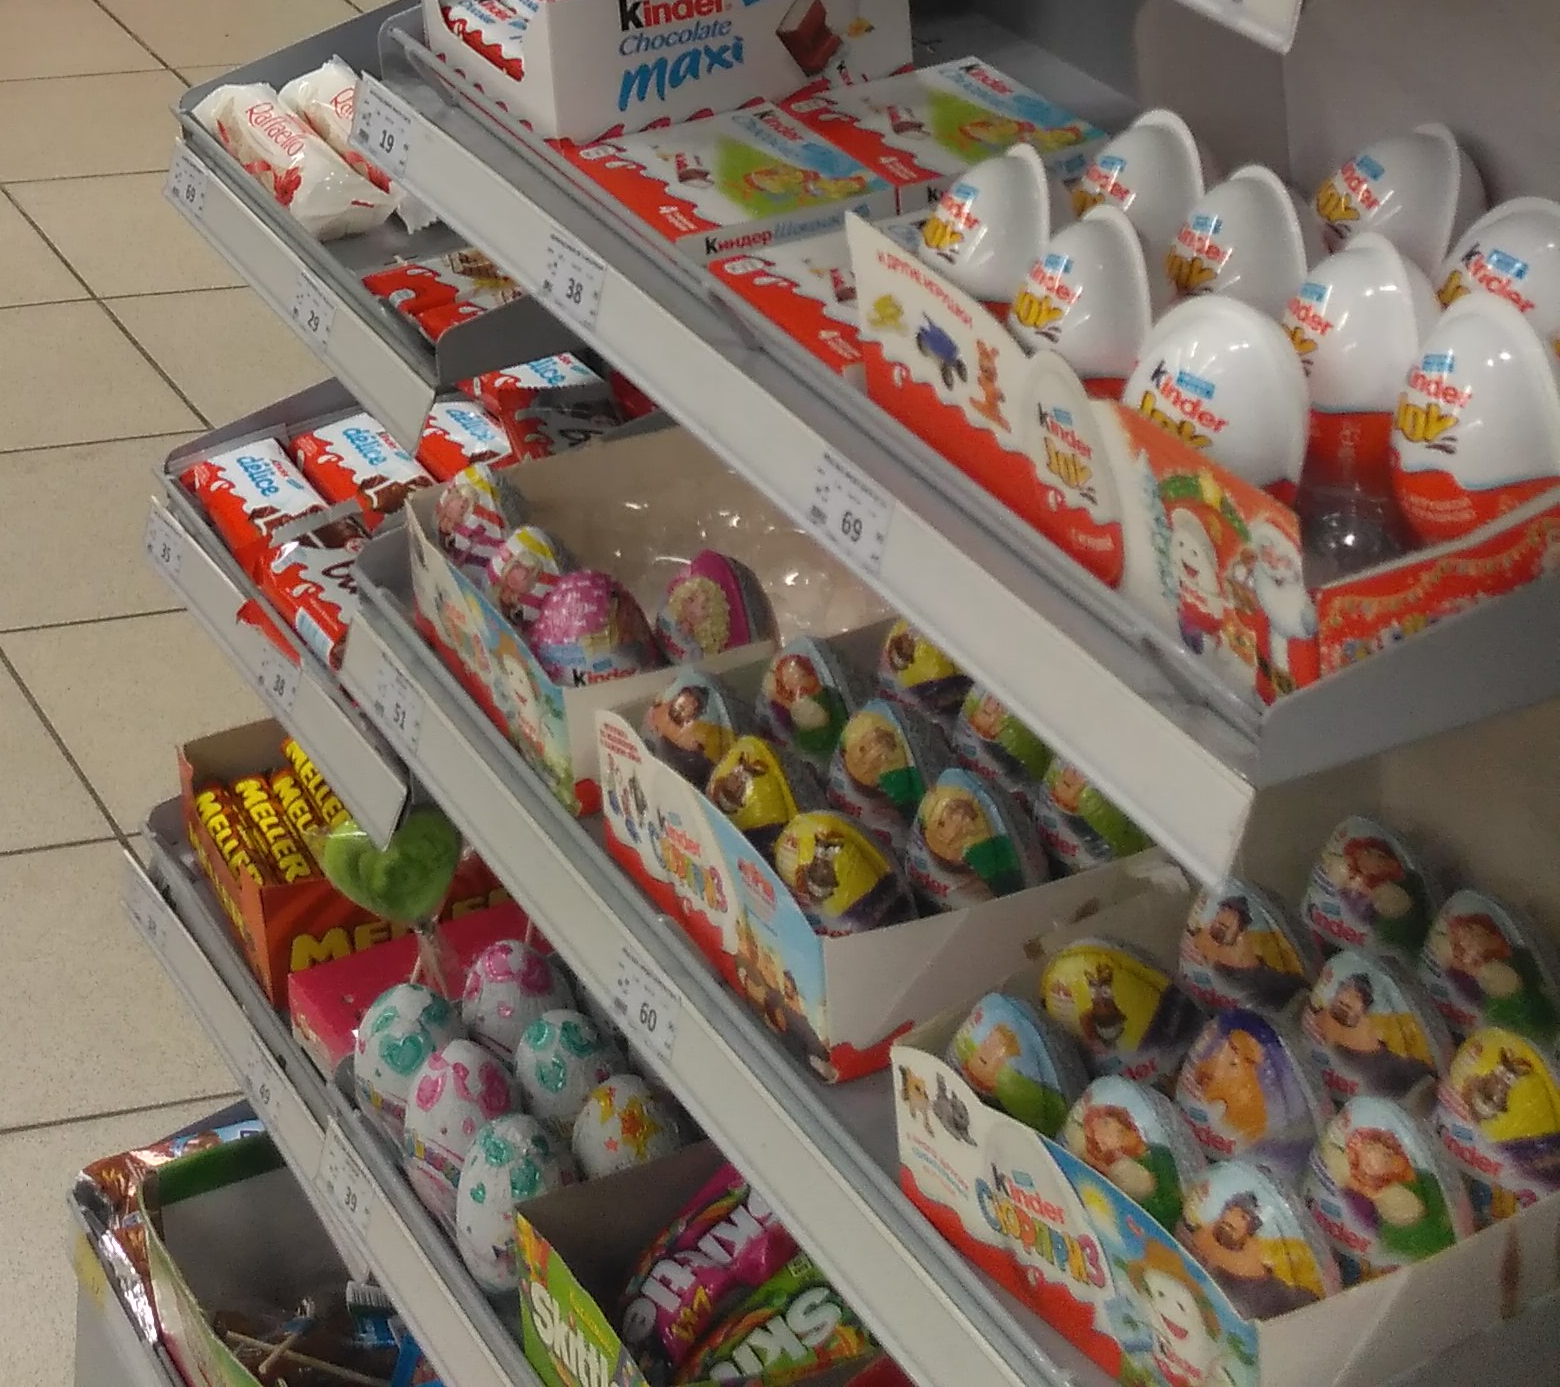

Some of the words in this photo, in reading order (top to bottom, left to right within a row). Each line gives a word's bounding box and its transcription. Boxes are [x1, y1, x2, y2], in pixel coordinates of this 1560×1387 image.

[618, 18, 733, 58] Chocolate
[617, 35, 744, 113] maxi
[245, 100, 306, 157] Raffaello
[378, 129, 395, 154] 19
[185, 184, 196, 204] 69
[705, 230, 774, 255] Киндер
[565, 277, 584, 305] 38
[306, 309, 320, 333] 29
[1038, 402, 1093, 458] Kinder
[342, 426, 388, 468] délice
[236, 454, 281, 498] délice
[842, 510, 863, 543] 69
[160, 542, 172, 563] 35
[273, 674, 285, 696] 38
[392, 701, 407, 730] 51
[235, 778, 311, 884] MELLER
[640, 1002, 657, 1032] 60
[344, 1186, 358, 1213] 39
[991, 1162, 1066, 1225] Kinder
